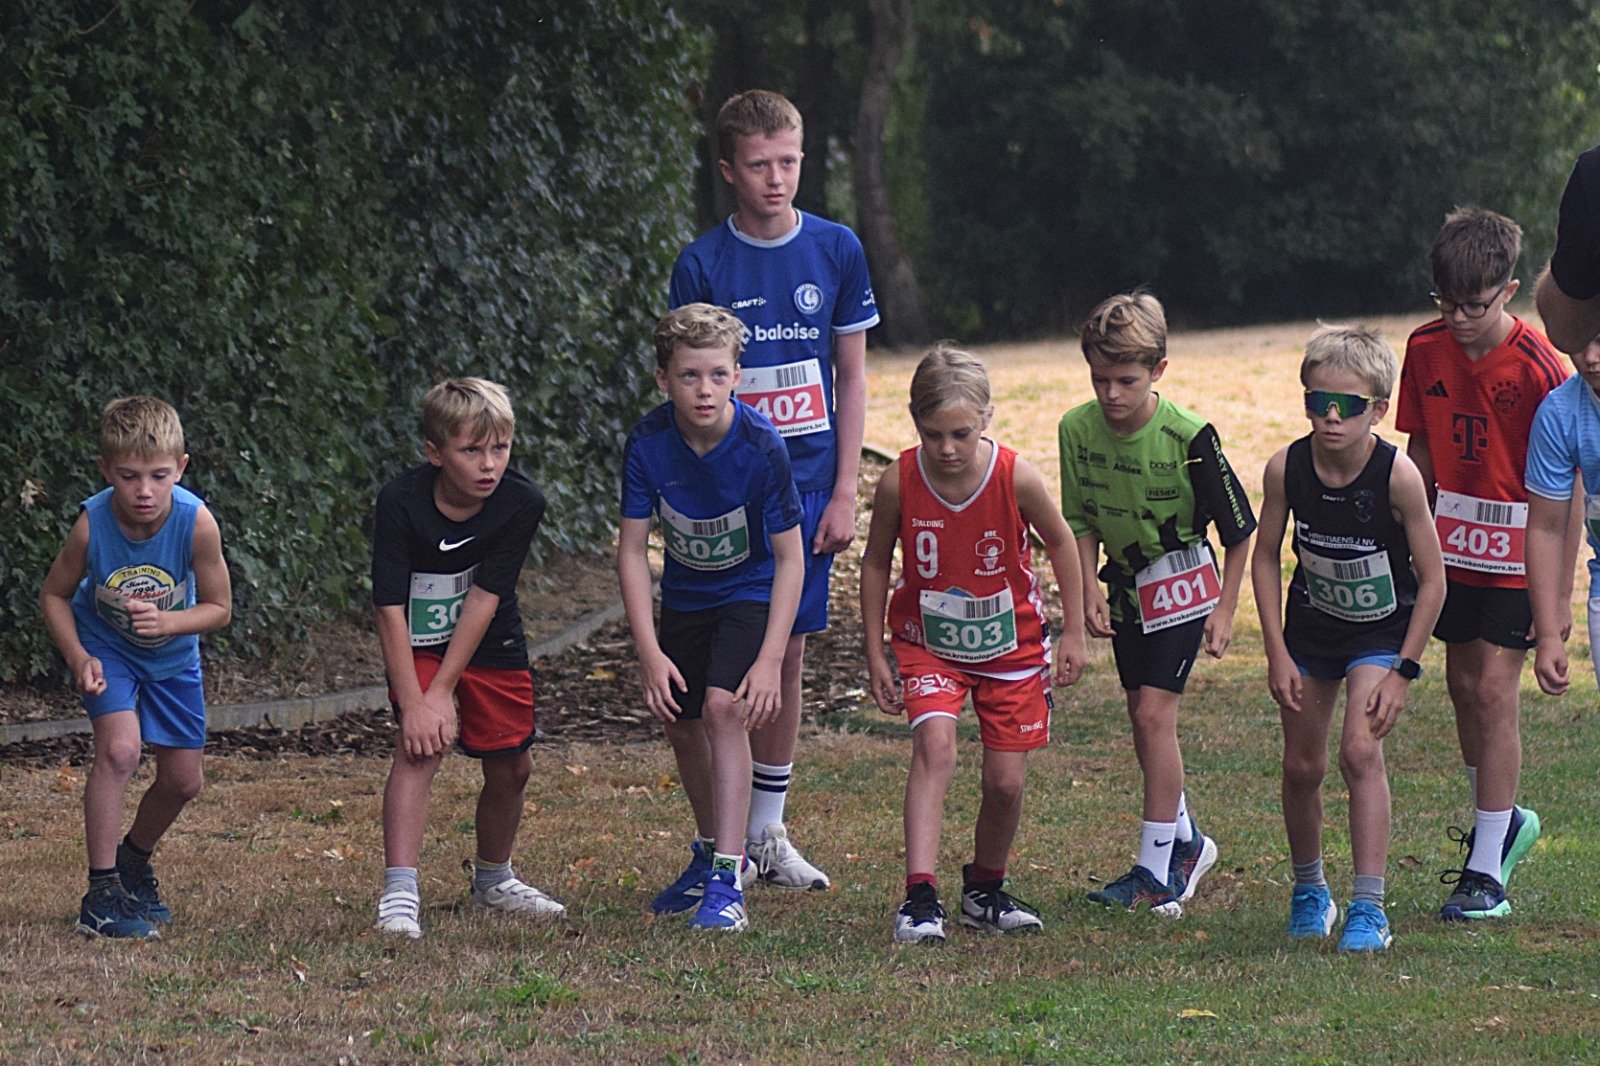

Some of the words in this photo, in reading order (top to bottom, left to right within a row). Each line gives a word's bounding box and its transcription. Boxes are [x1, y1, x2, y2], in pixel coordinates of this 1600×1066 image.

[732, 299, 758, 310] CRAFT
[754, 322, 820, 341] baloise
[754, 391, 814, 422] 402
[1211, 435, 1228, 473] LUCKY
[1222, 473, 1246, 529] RUNNERS
[912, 518, 944, 528] SPALDING
[672, 531, 734, 559] 304
[916, 531, 938, 579] 9
[1446, 525, 1511, 559] 403
[121, 567, 161, 578] TRAINING
[1443, 556, 1518, 572] ww.krekenlopers.be
[1152, 573, 1208, 611] 401
[1315, 579, 1378, 608] 306
[939, 620, 1003, 649] 303
[908, 673, 948, 692] DSV
